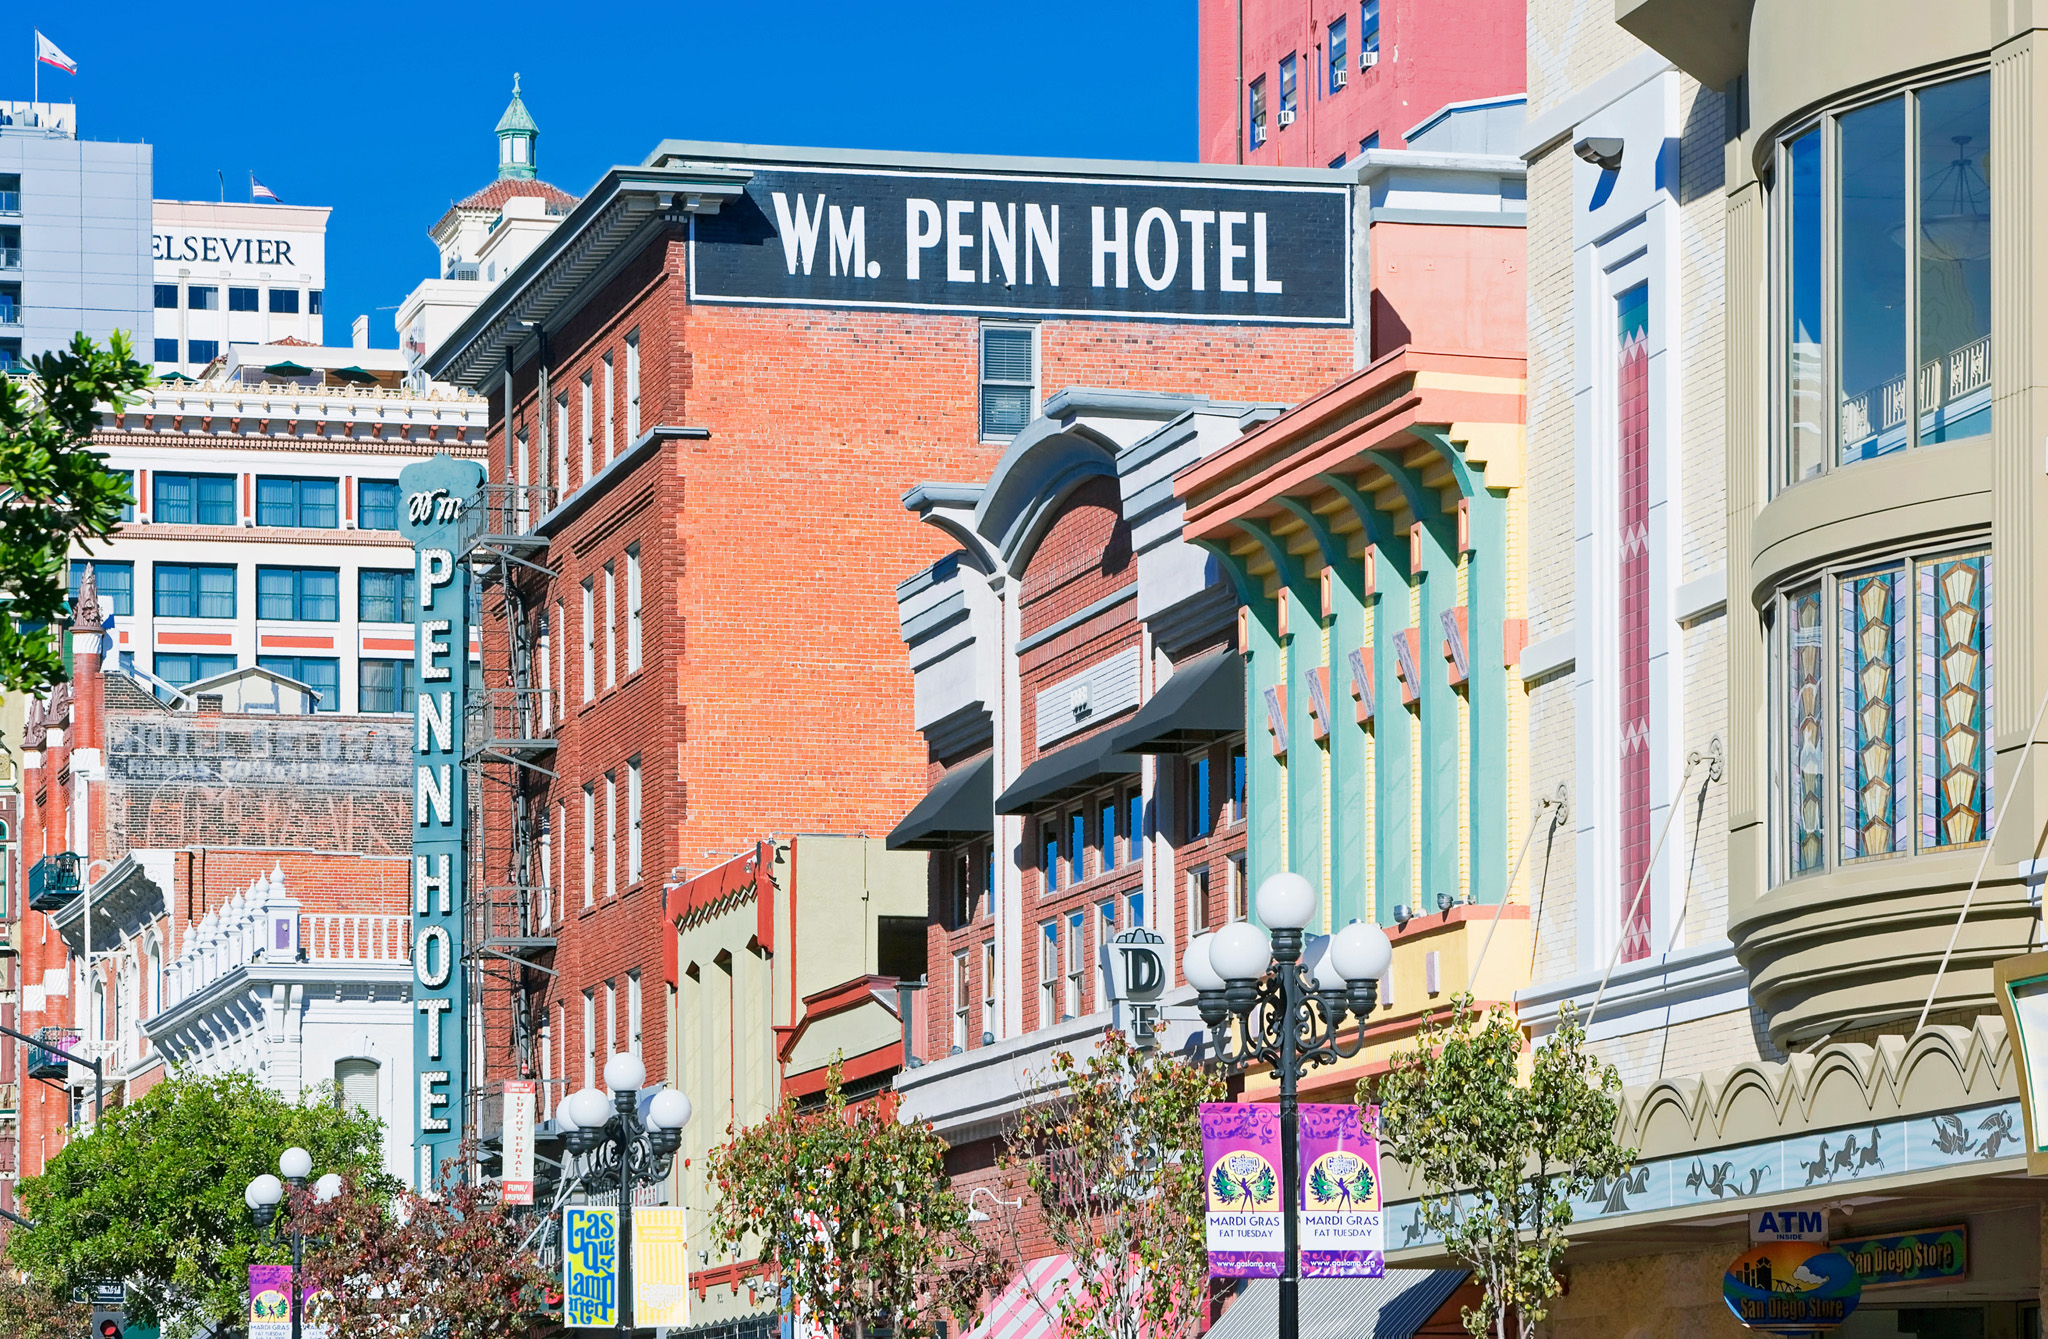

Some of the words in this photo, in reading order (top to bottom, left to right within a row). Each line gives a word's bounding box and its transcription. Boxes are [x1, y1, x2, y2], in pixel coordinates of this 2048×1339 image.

[153, 235, 296, 266] ELSEVIER
[906, 198, 1059, 287] PENN
[1091, 206, 1283, 294] HOTEL
[417, 549, 452, 823] PENN
[416, 854, 451, 1201] HOTEL
[515, 1136, 523, 1177] RENTALS
[1210, 1217, 1246, 1226] MARDI
[1250, 1217, 1280, 1226] GRAS
[1306, 1216, 1342, 1226] MARDI
[1346, 1216, 1379, 1226] GRAS
[1758, 1212, 1822, 1233] ATM
[1219, 1230, 1234, 1238] FAT
[1237, 1230, 1273, 1238] TUESDAY
[1314, 1229, 1329, 1237] FAT
[1333, 1229, 1372, 1237] TUESDAY
[1216, 1260, 1277, 1269] www.gaslamp.org
[1310, 1260, 1376, 1269] www.gaslamp.org
[1848, 1251, 1871, 1273] San
[1874, 1246, 1912, 1272] Diego
[1915, 1242, 1952, 1267] Store
[1741, 1297, 1764, 1318] San
[1769, 1297, 1806, 1320] Diego
[1809, 1297, 1843, 1317] Store
